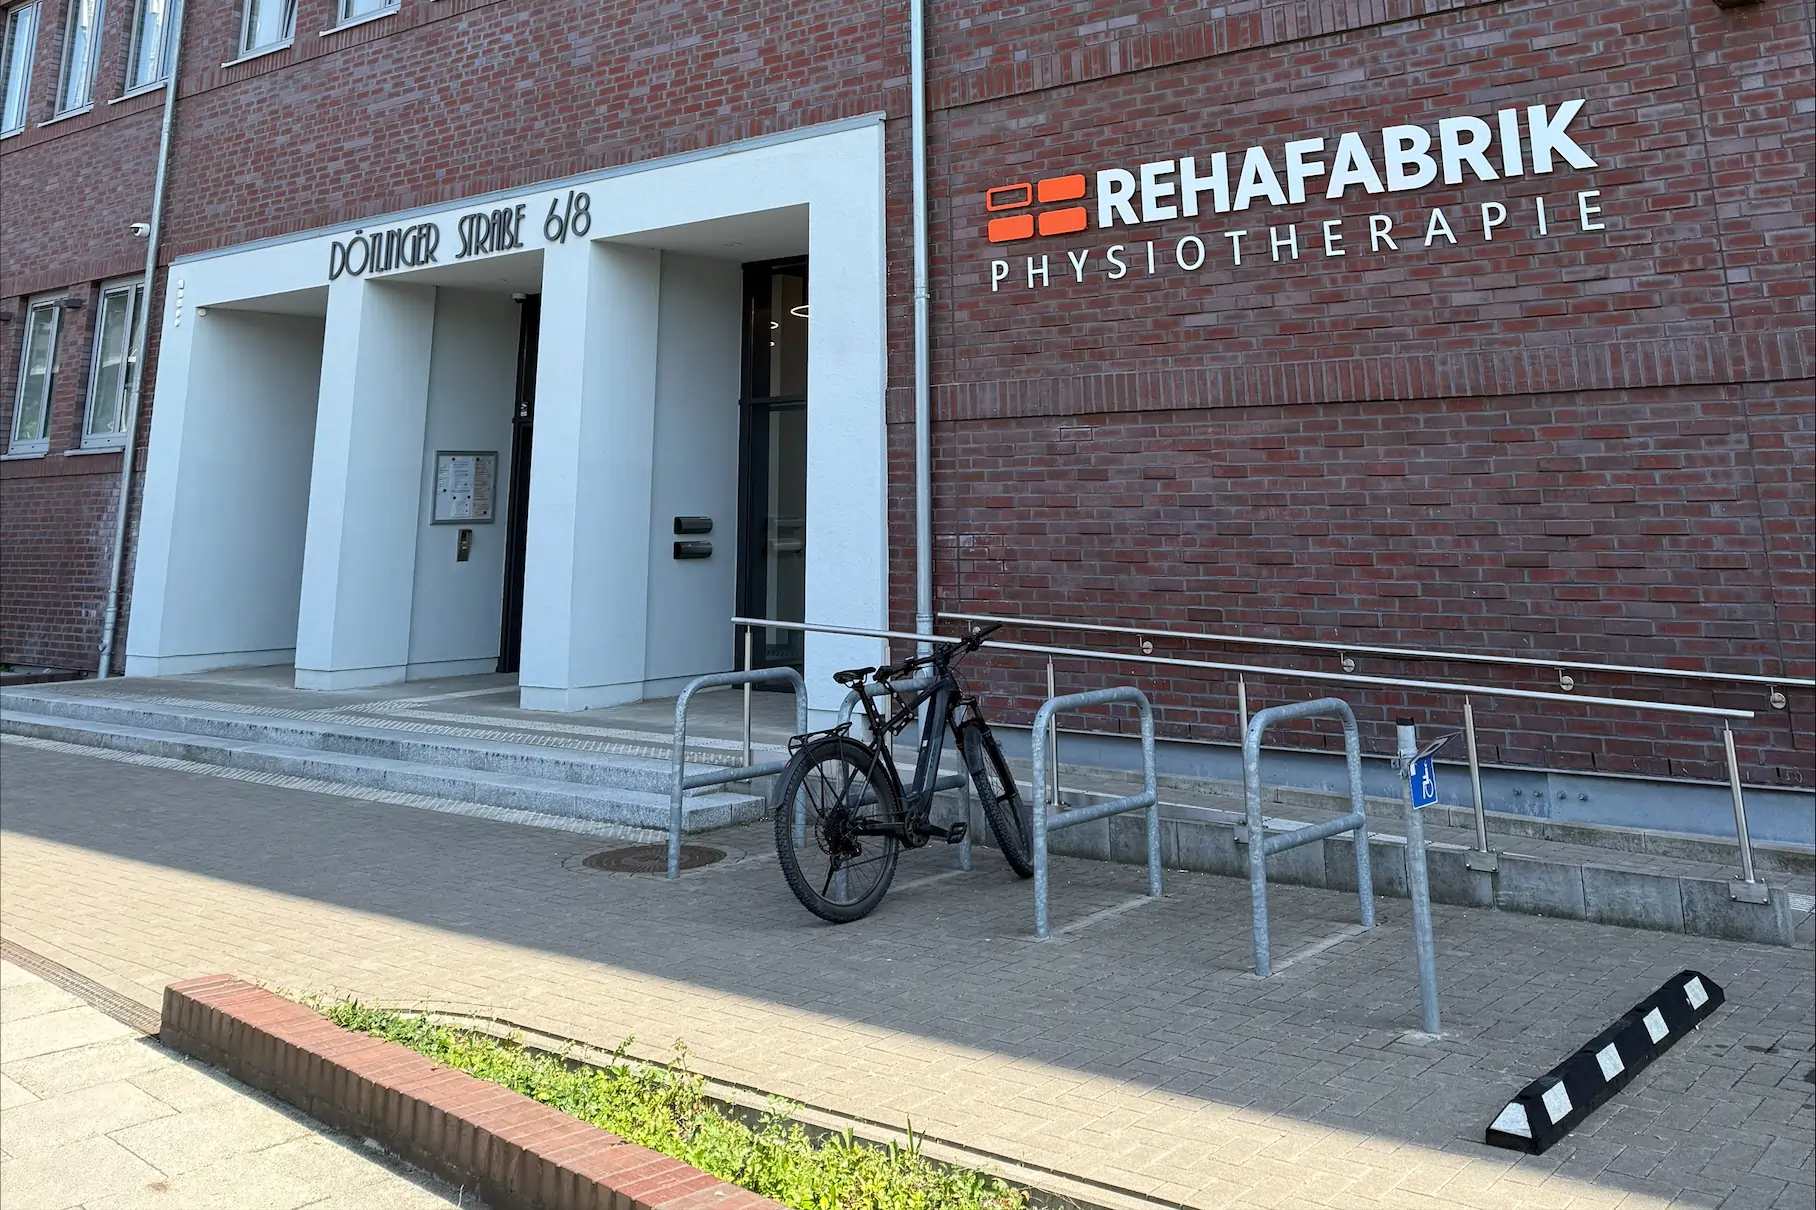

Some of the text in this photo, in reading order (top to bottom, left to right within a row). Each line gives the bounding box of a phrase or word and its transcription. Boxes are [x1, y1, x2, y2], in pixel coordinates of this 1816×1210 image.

[1096, 99, 1598, 229] REHAFABRIK
[329, 222, 440, 280] DÖTLINGER
[544, 190, 591, 244] 6/8
[991, 190, 1605, 292] PHYSIOTHERAPIE
